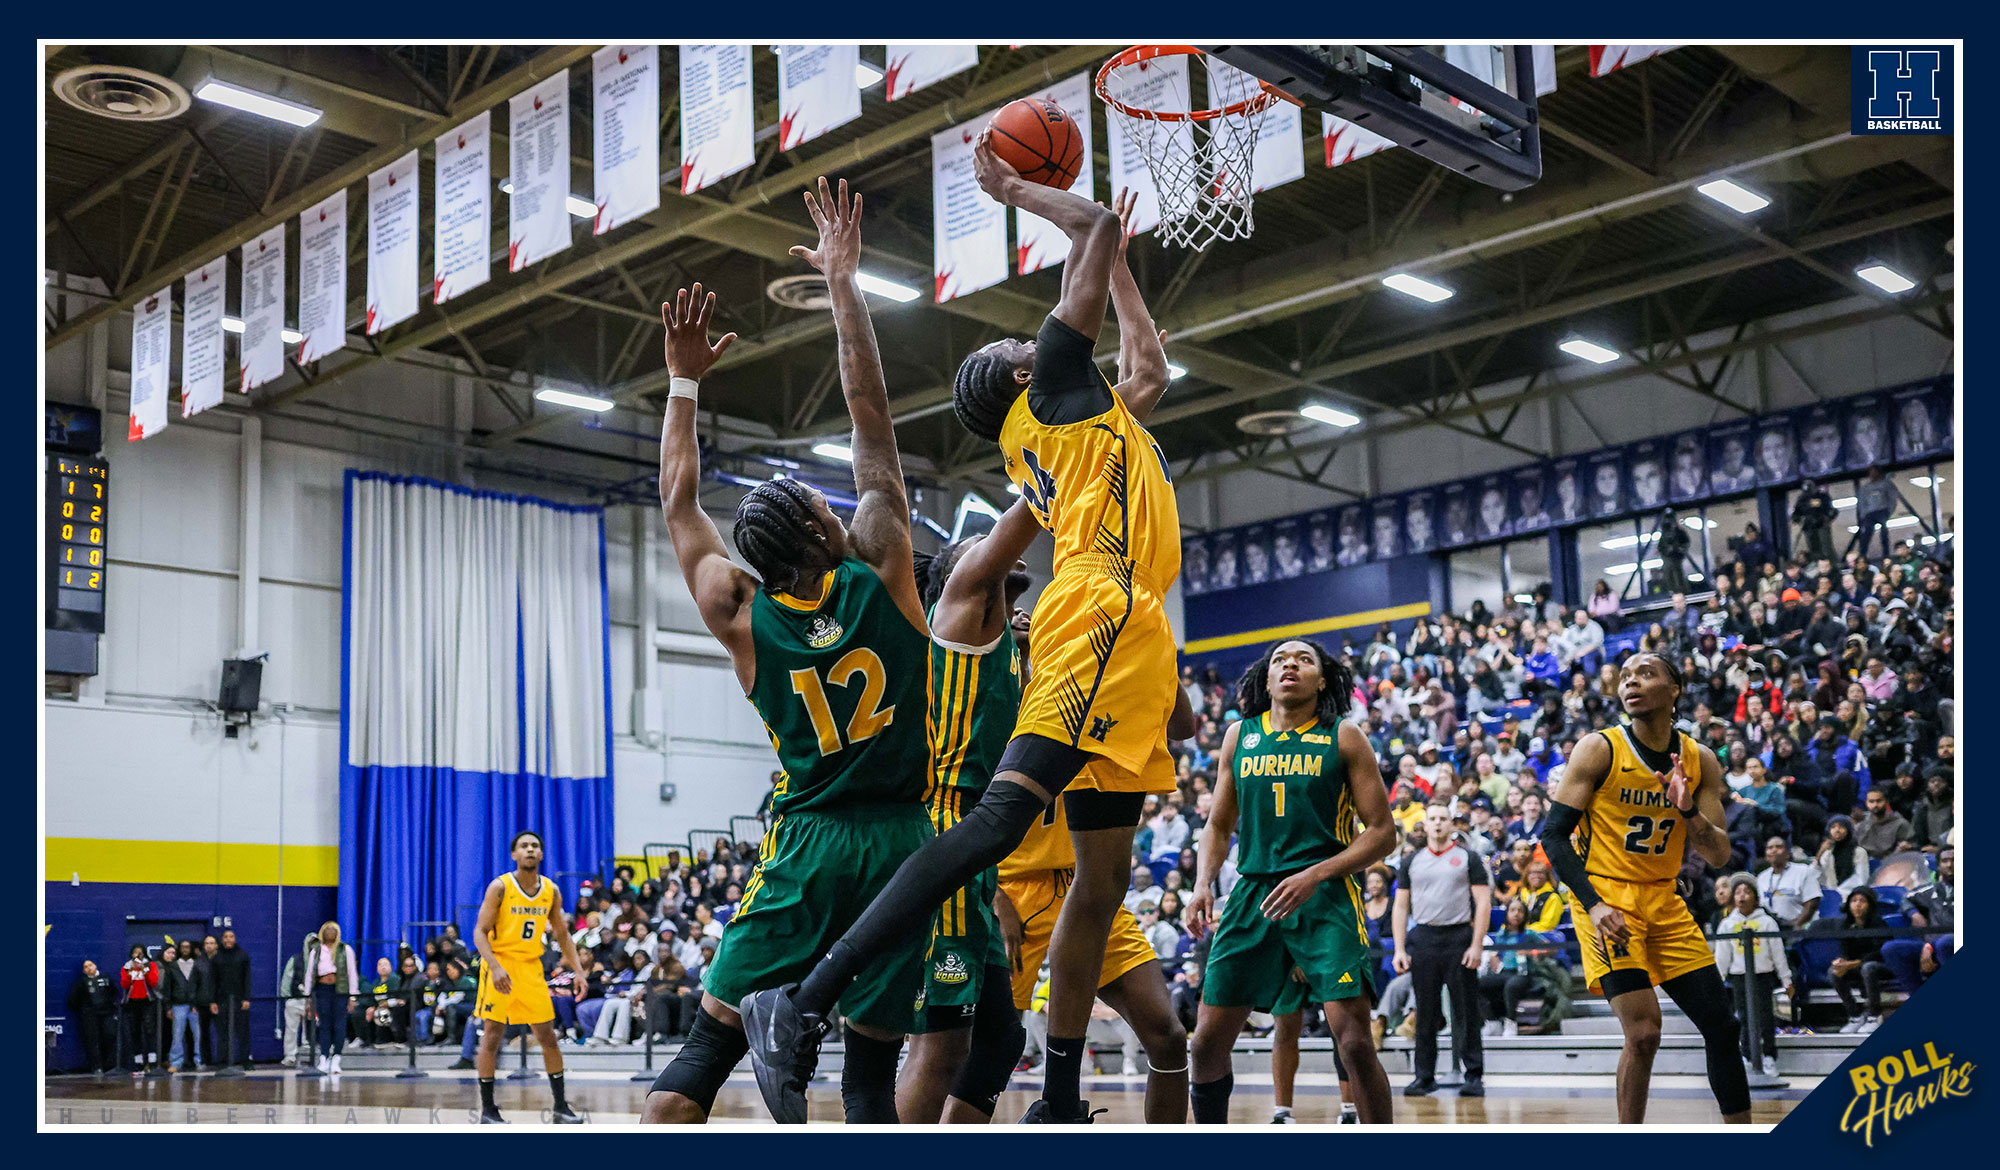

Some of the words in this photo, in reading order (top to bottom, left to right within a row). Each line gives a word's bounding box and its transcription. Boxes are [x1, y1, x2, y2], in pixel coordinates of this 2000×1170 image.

[68, 481, 75, 495] 1
[92, 483, 103, 500] 7
[62, 501, 74, 519] 0
[90, 505, 102, 522] 2
[61, 523, 74, 541] 0
[89, 527, 102, 544] 0
[66, 548, 73, 562] 1
[89, 549, 101, 566] 0
[65, 570, 72, 585] 1
[88, 571, 100, 588] 2
[789, 647, 896, 757] 12
[1240, 754, 1322, 778] DURHAM
[1272, 782, 1286, 817] 1
[1624, 815, 1676, 855] 23
[511, 905, 548, 917] HUMBER
[522, 920, 535, 940] 6
[935, 971, 966, 981] LORDS
